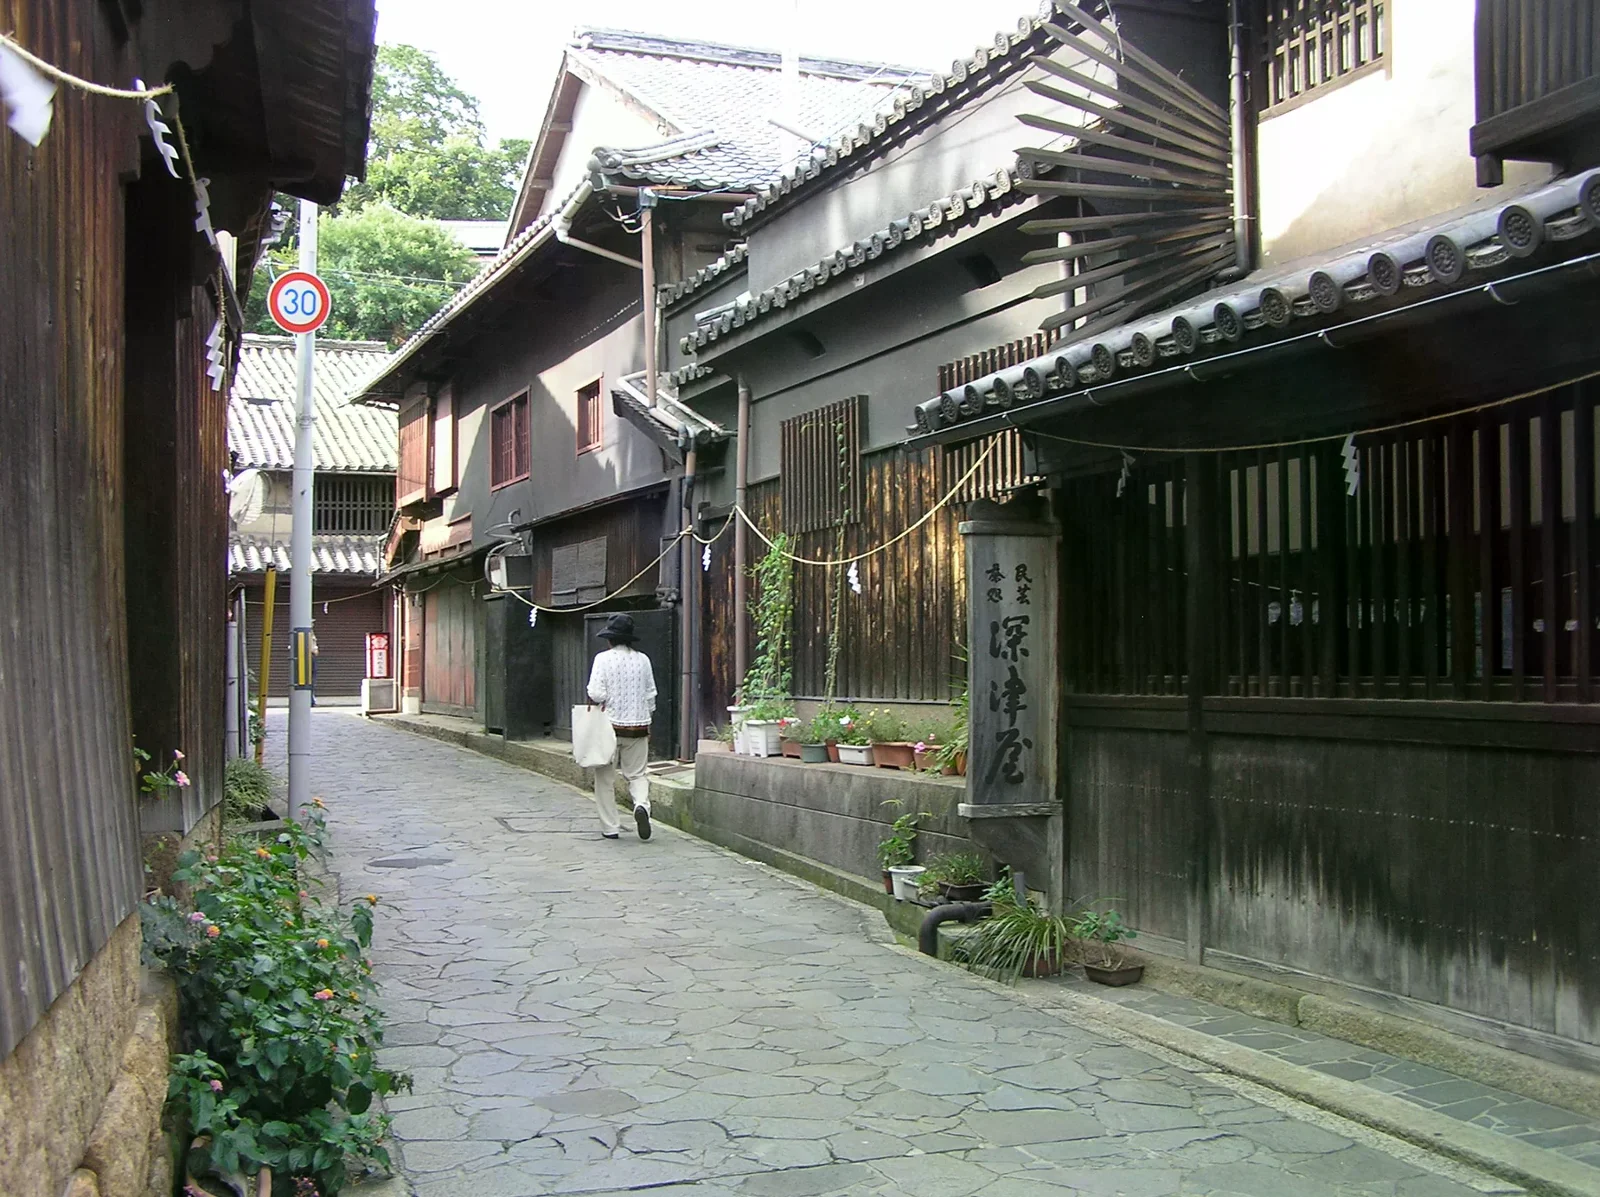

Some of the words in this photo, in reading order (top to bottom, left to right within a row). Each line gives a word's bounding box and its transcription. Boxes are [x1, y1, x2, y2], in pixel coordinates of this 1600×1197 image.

[284, 288, 316, 316] 30
[1015, 563, 1033, 605] 民芸
[984, 614, 1033, 784] 深津屋
